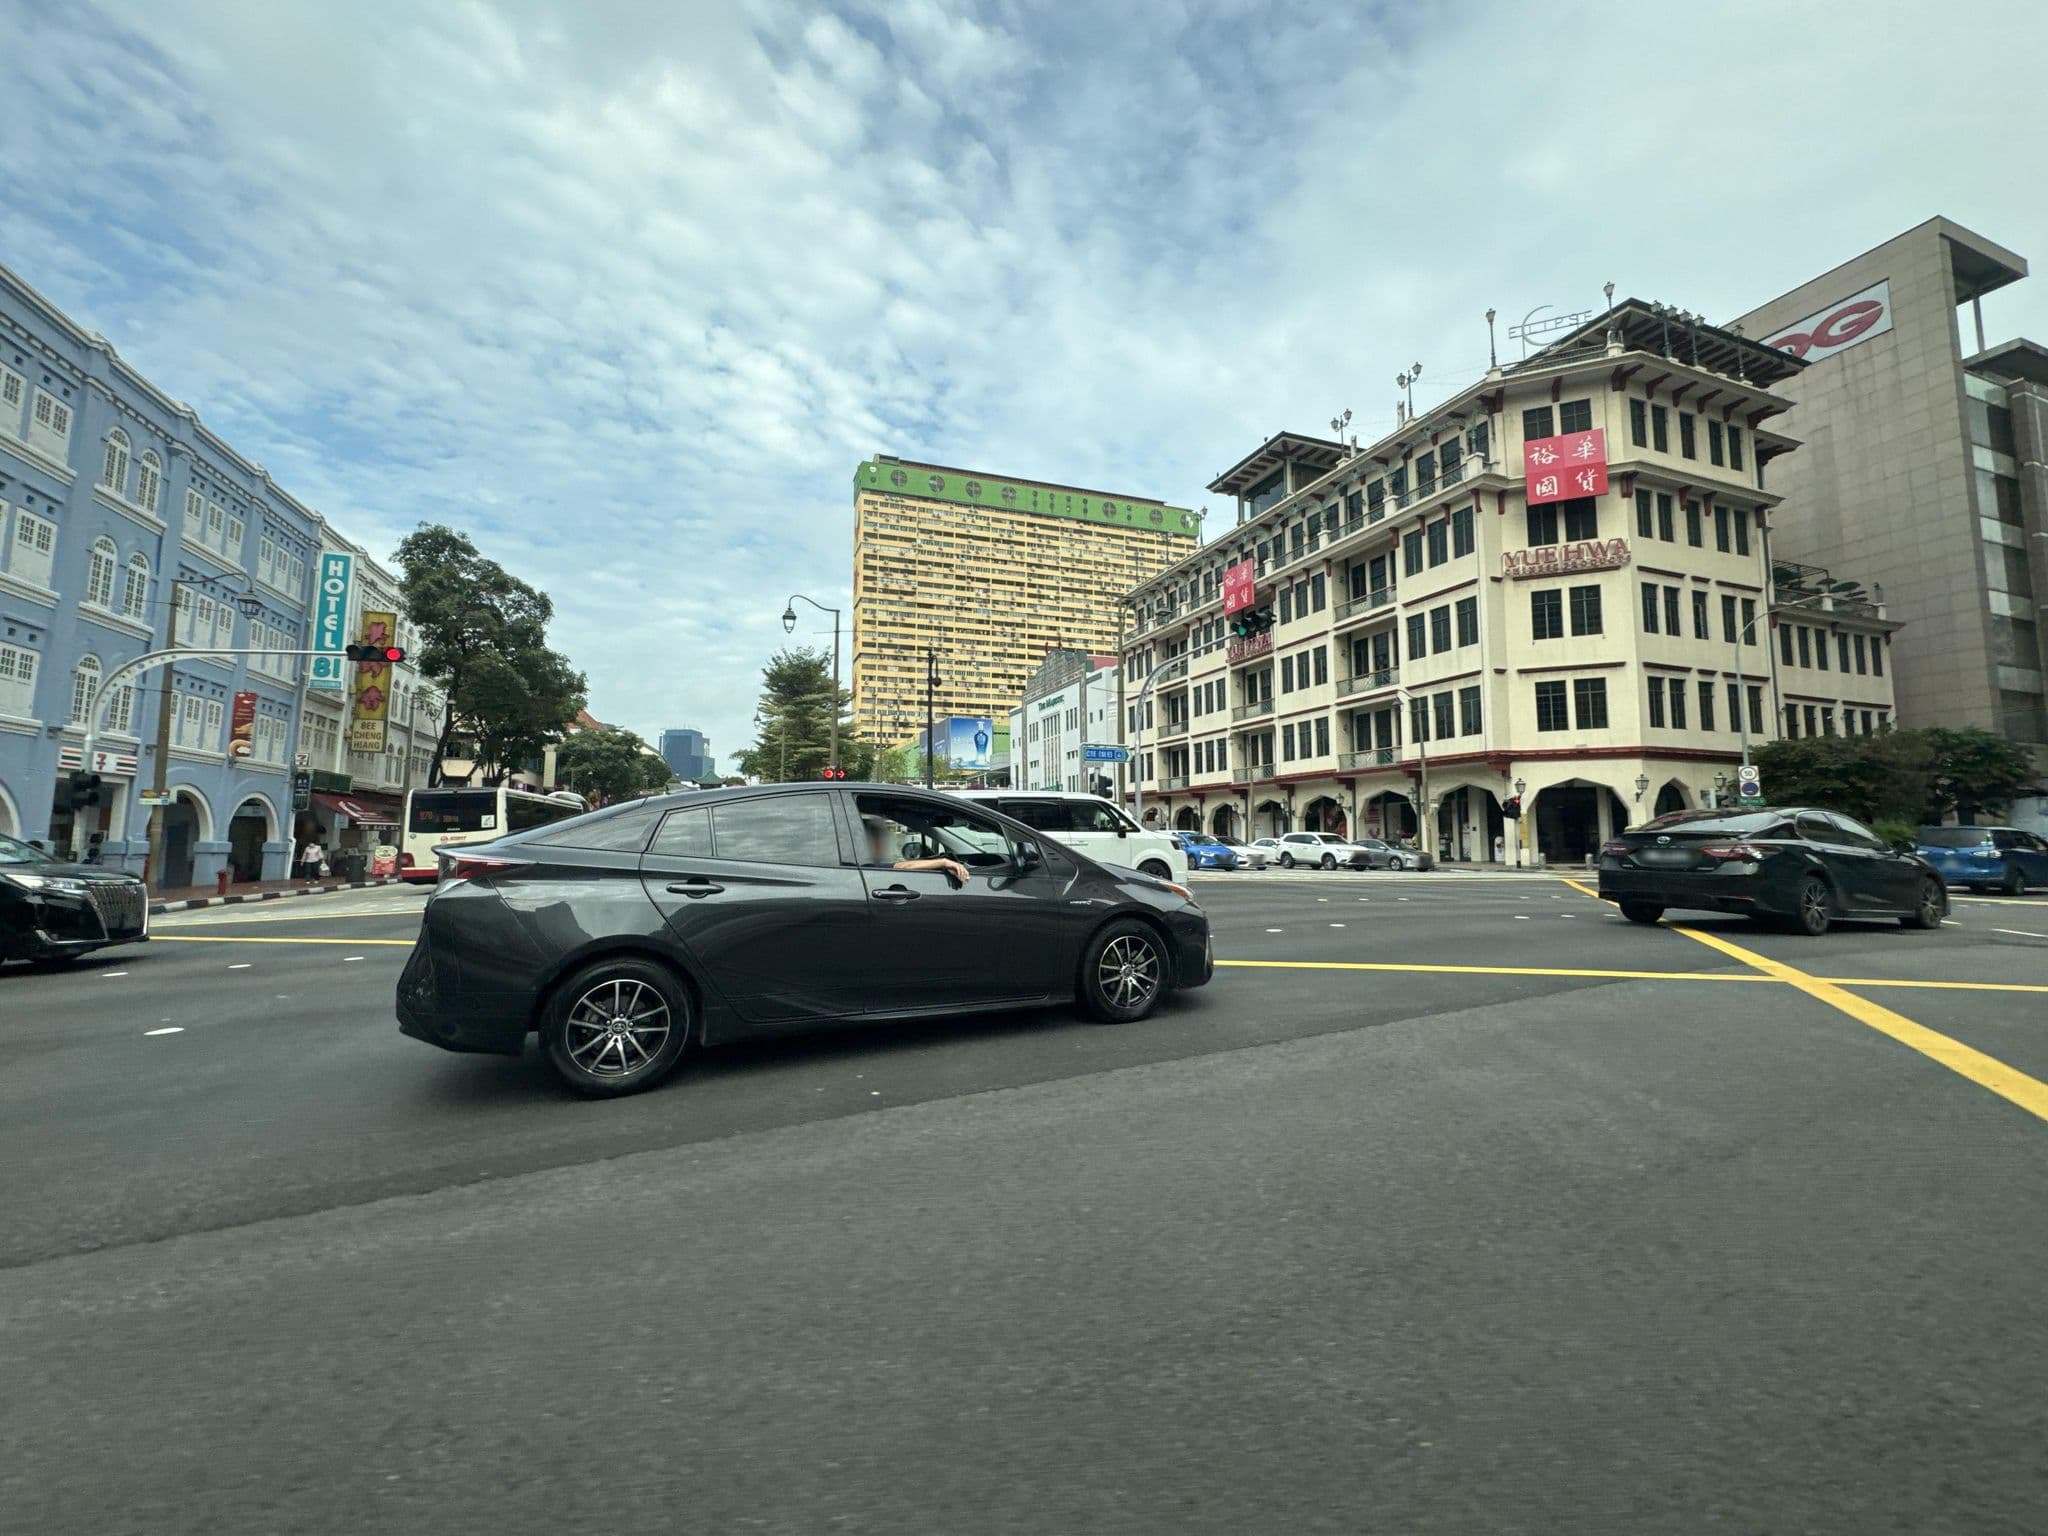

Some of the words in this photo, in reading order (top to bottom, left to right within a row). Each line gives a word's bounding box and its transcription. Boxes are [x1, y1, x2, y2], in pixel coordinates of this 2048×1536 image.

[1503, 545, 1558, 569] YUE
[1563, 537, 1632, 562] HWA
[323, 560, 345, 649] HOTEL
[312, 657, 341, 679] 81
[361, 721, 376, 730] BEE
[353, 731, 382, 740] CHENG
[353, 741, 380, 749] HIANG
